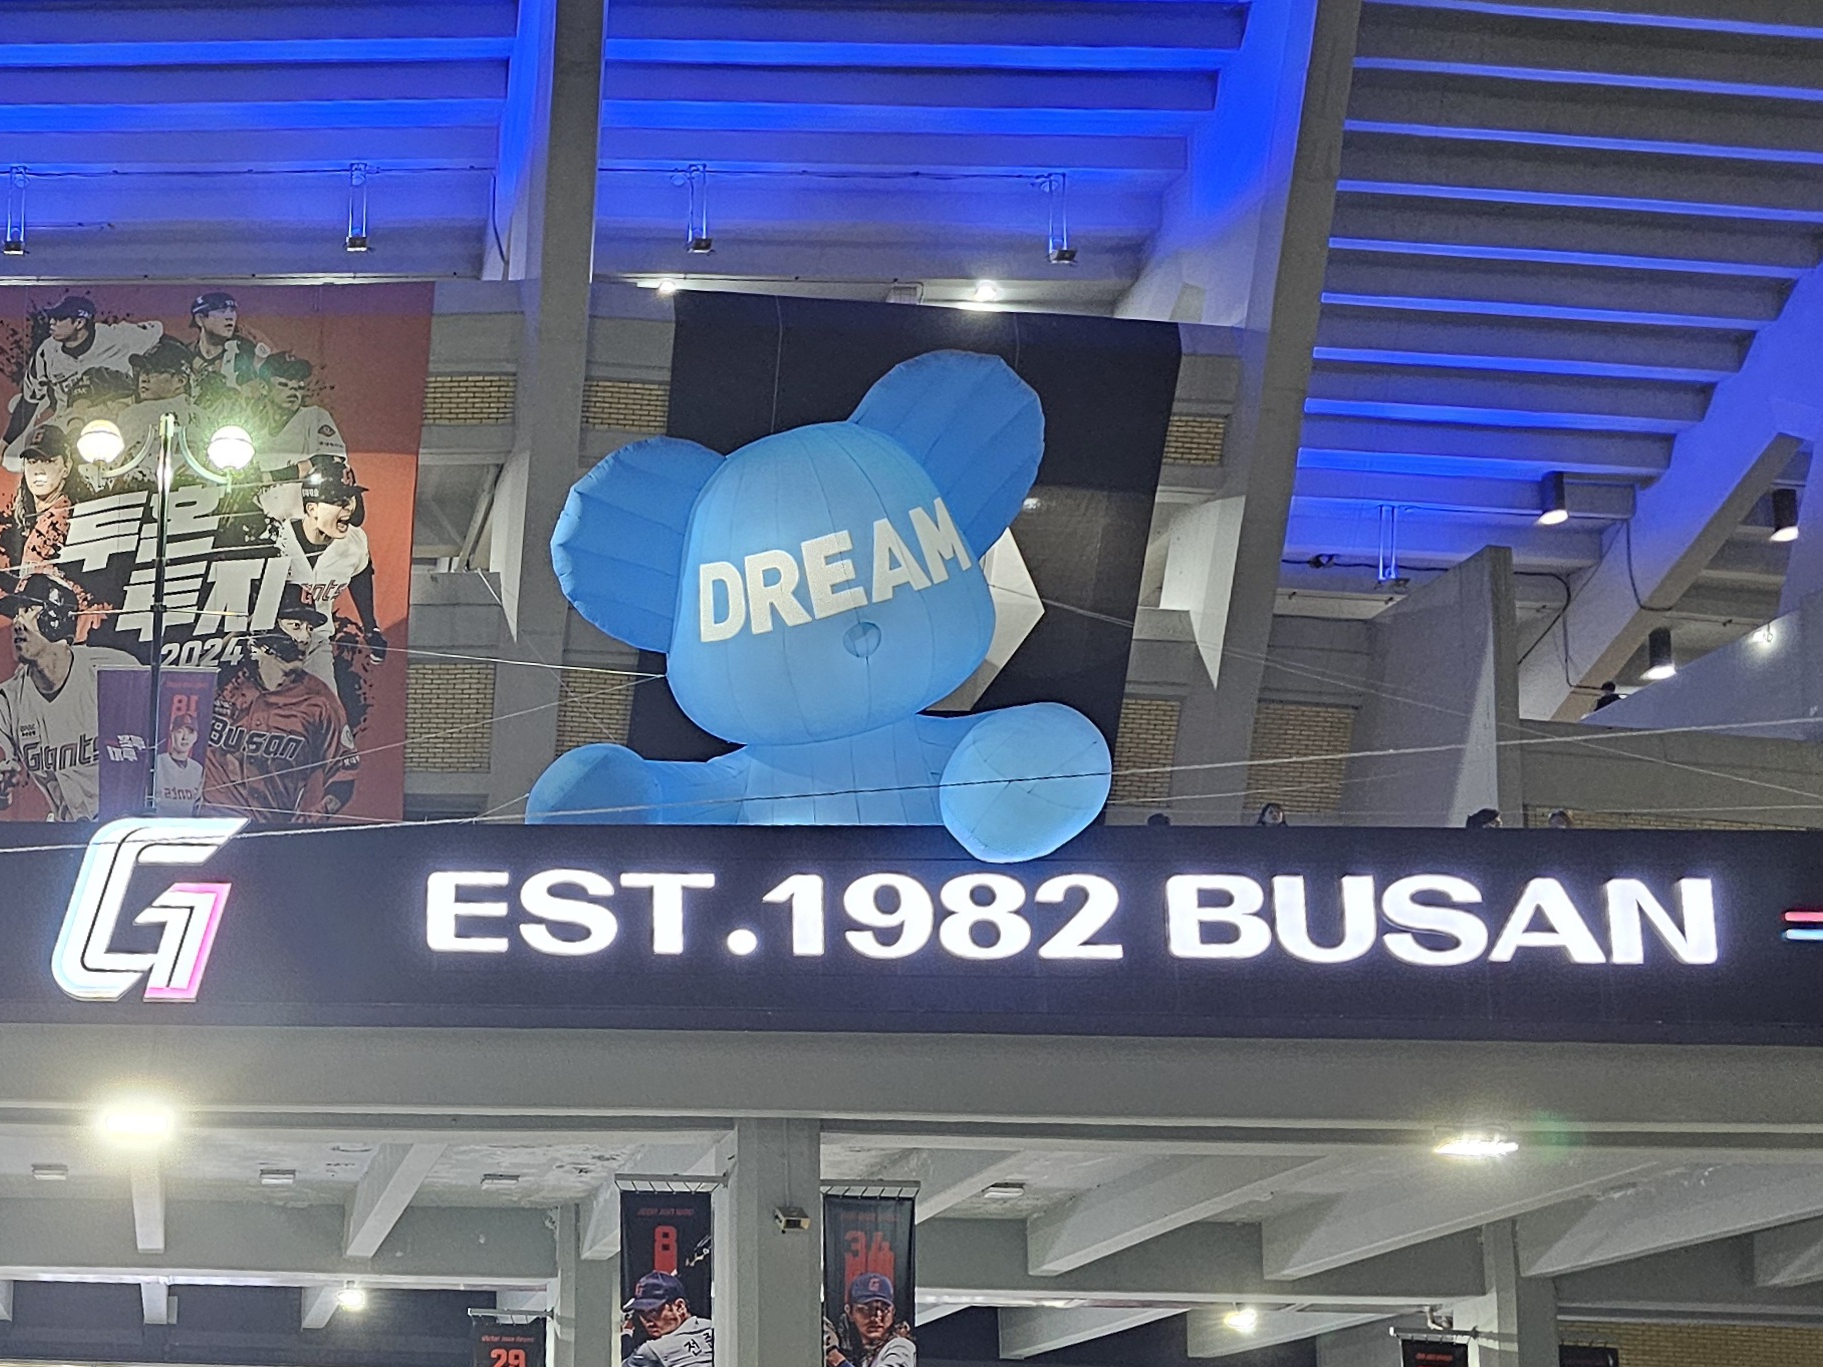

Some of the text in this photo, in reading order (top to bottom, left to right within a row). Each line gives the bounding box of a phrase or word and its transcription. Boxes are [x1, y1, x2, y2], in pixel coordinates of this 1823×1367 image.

[698, 497, 973, 643] DREAM
[161, 637, 244, 667] 2024
[209, 716, 306, 760] Busan
[425, 869, 1719, 968] EST.1982 BUSAN
[654, 1225, 677, 1253] 8
[844, 1230, 893, 1257] 34
